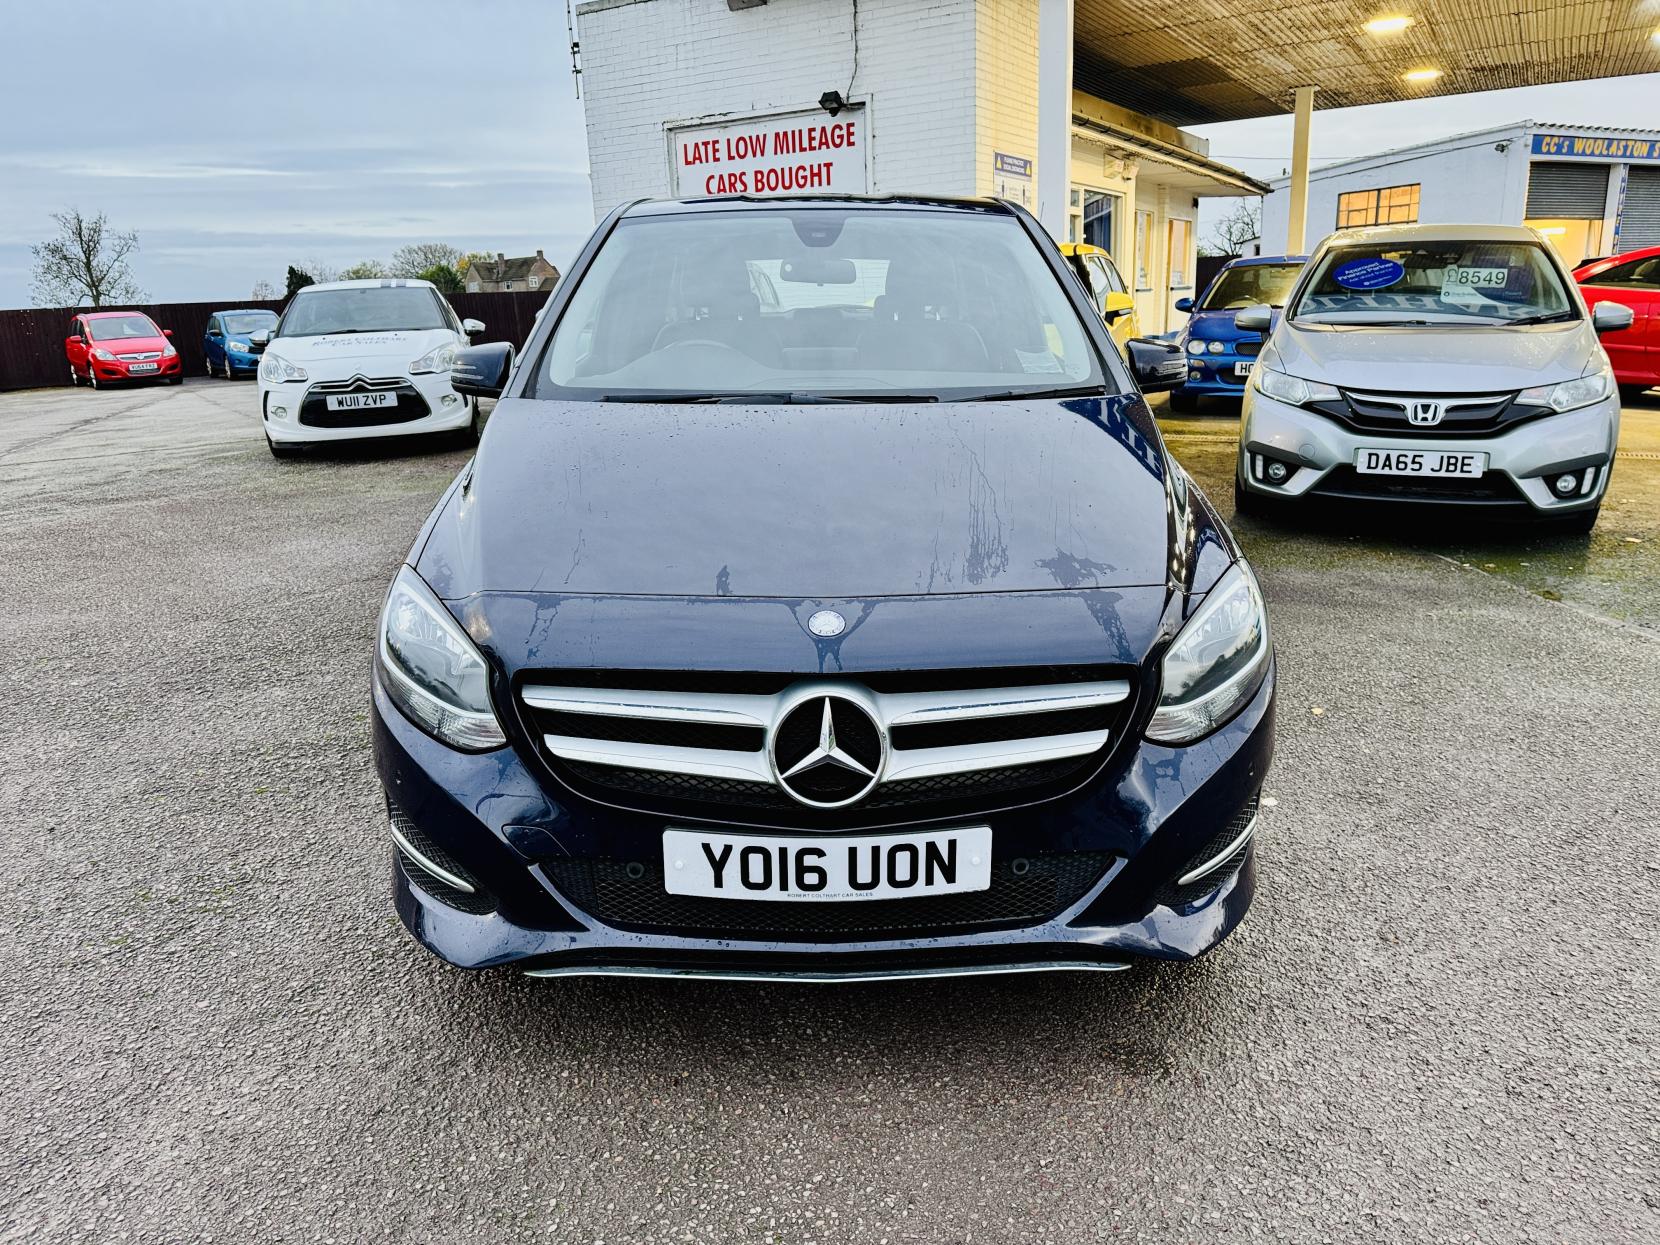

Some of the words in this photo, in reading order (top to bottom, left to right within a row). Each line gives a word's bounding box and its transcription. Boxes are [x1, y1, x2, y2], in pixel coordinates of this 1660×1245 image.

[684, 139, 720, 166] LATE
[726, 133, 767, 161] LOW
[774, 122, 856, 155] MILEAGE
[1541, 136, 1569, 153] CC's
[1573, 138, 1650, 157] WOOLASTON
[705, 171, 748, 195] CARS
[754, 162, 833, 193] BOUGHT
[336, 395, 360, 407] WU11
[362, 394, 387, 406] ZVP
[1366, 452, 1424, 472] DA65
[1430, 455, 1475, 474] JBE
[701, 842, 828, 892] YO16
[848, 838, 957, 891] UON
